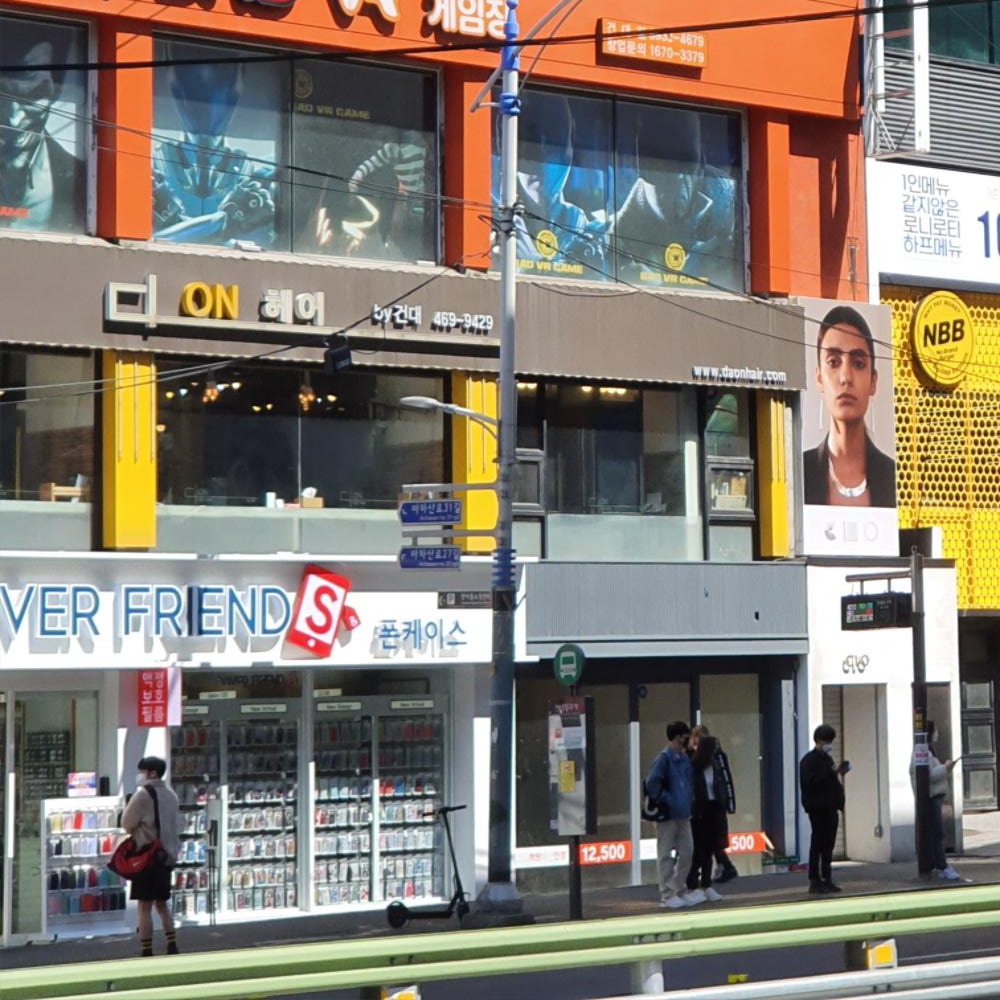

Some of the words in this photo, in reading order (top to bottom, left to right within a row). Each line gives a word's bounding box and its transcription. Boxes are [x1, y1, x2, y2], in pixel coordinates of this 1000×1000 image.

[650, 45, 704, 63] 1670-3379
[901, 174, 950, 195] 1인메뉴
[903, 217, 961, 239] 로니로티
[904, 235, 962, 258] 하프메뉴
[553, 264, 583, 274] GAME
[182, 281, 239, 319] ON
[260, 288, 324, 326] 헤어
[433, 311, 493, 330] 469-9429
[923, 319, 965, 347] NBB
[693, 365, 787, 381] www.daonhair.com
[0, 585, 101, 636] VER
[378, 618, 468, 650] 폰케이스
[582, 843, 625, 861] 12,500
